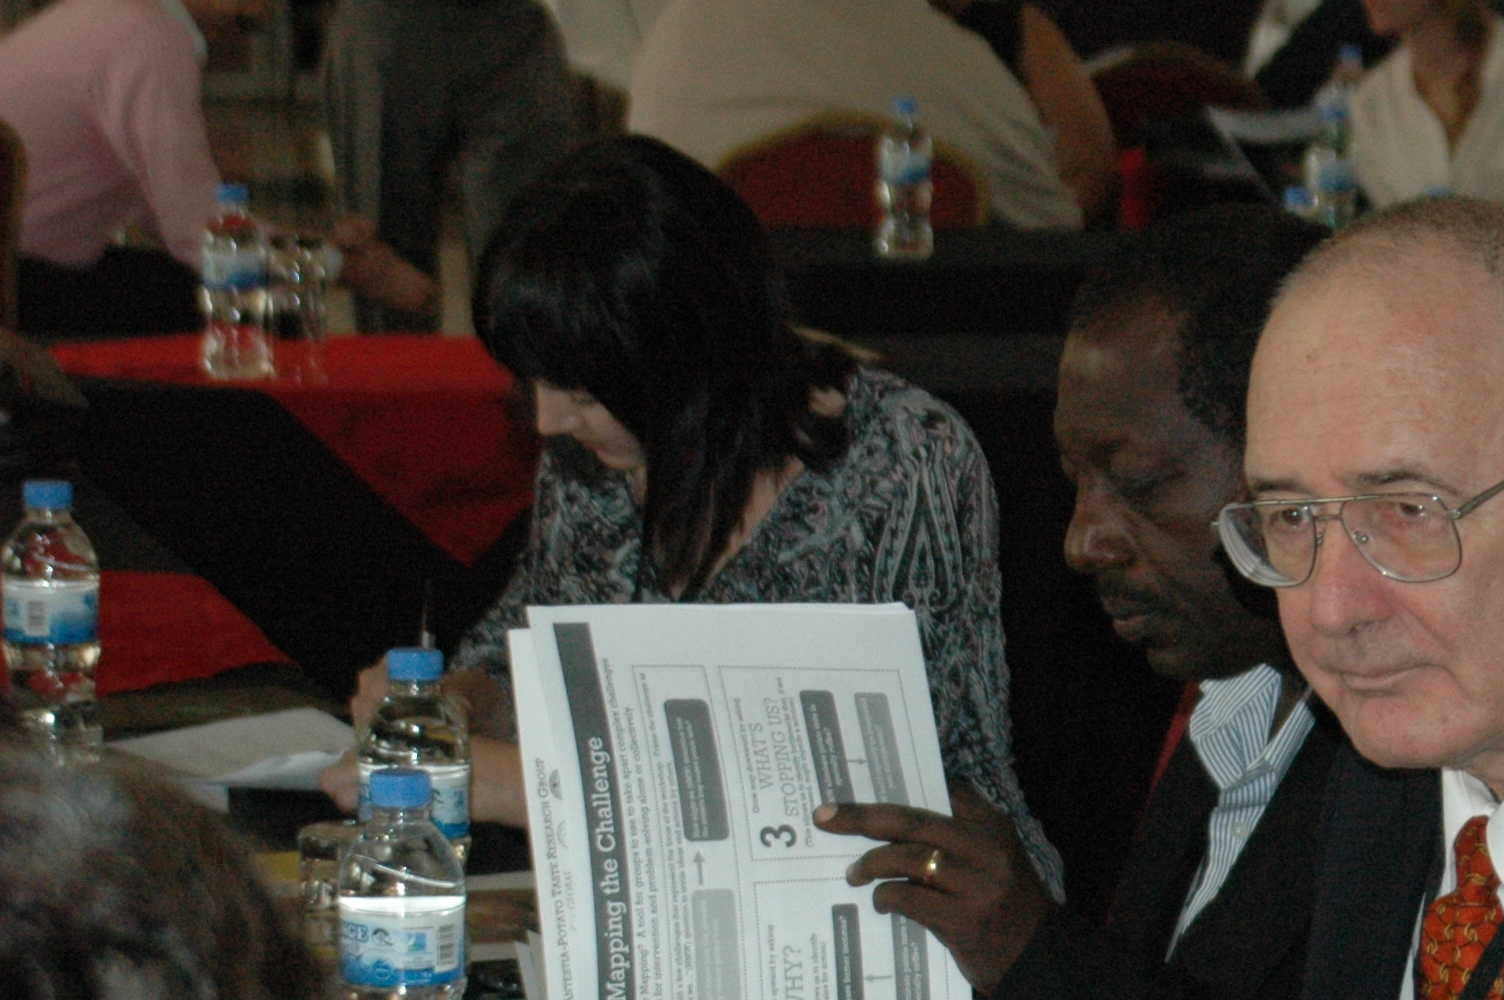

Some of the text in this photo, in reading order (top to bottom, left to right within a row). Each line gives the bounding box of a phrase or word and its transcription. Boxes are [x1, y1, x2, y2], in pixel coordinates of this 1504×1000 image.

[601, 658, 619, 707] challenges
[610, 711, 627, 751] complex
[747, 721, 774, 789] WHAT'S
[762, 696, 800, 816] STOPPING US?
[534, 757, 549, 799] GROUP
[587, 736, 616, 853] Challenge
[623, 782, 634, 803] take
[627, 806, 635, 816] to
[628, 819, 638, 836] use
[540, 800, 558, 860] RESEARCH
[630, 840, 640, 848] to
[760, 824, 797, 848] 3
[550, 862, 562, 898] TASTE
[599, 859, 621, 895] the
[632, 852, 645, 887] groups
[634, 892, 644, 904] for
[649, 895, 658, 912] and
[634, 908, 646, 928] tool
[636, 944, 652, 994] Mapping?
[653, 983, 663, 995] for
